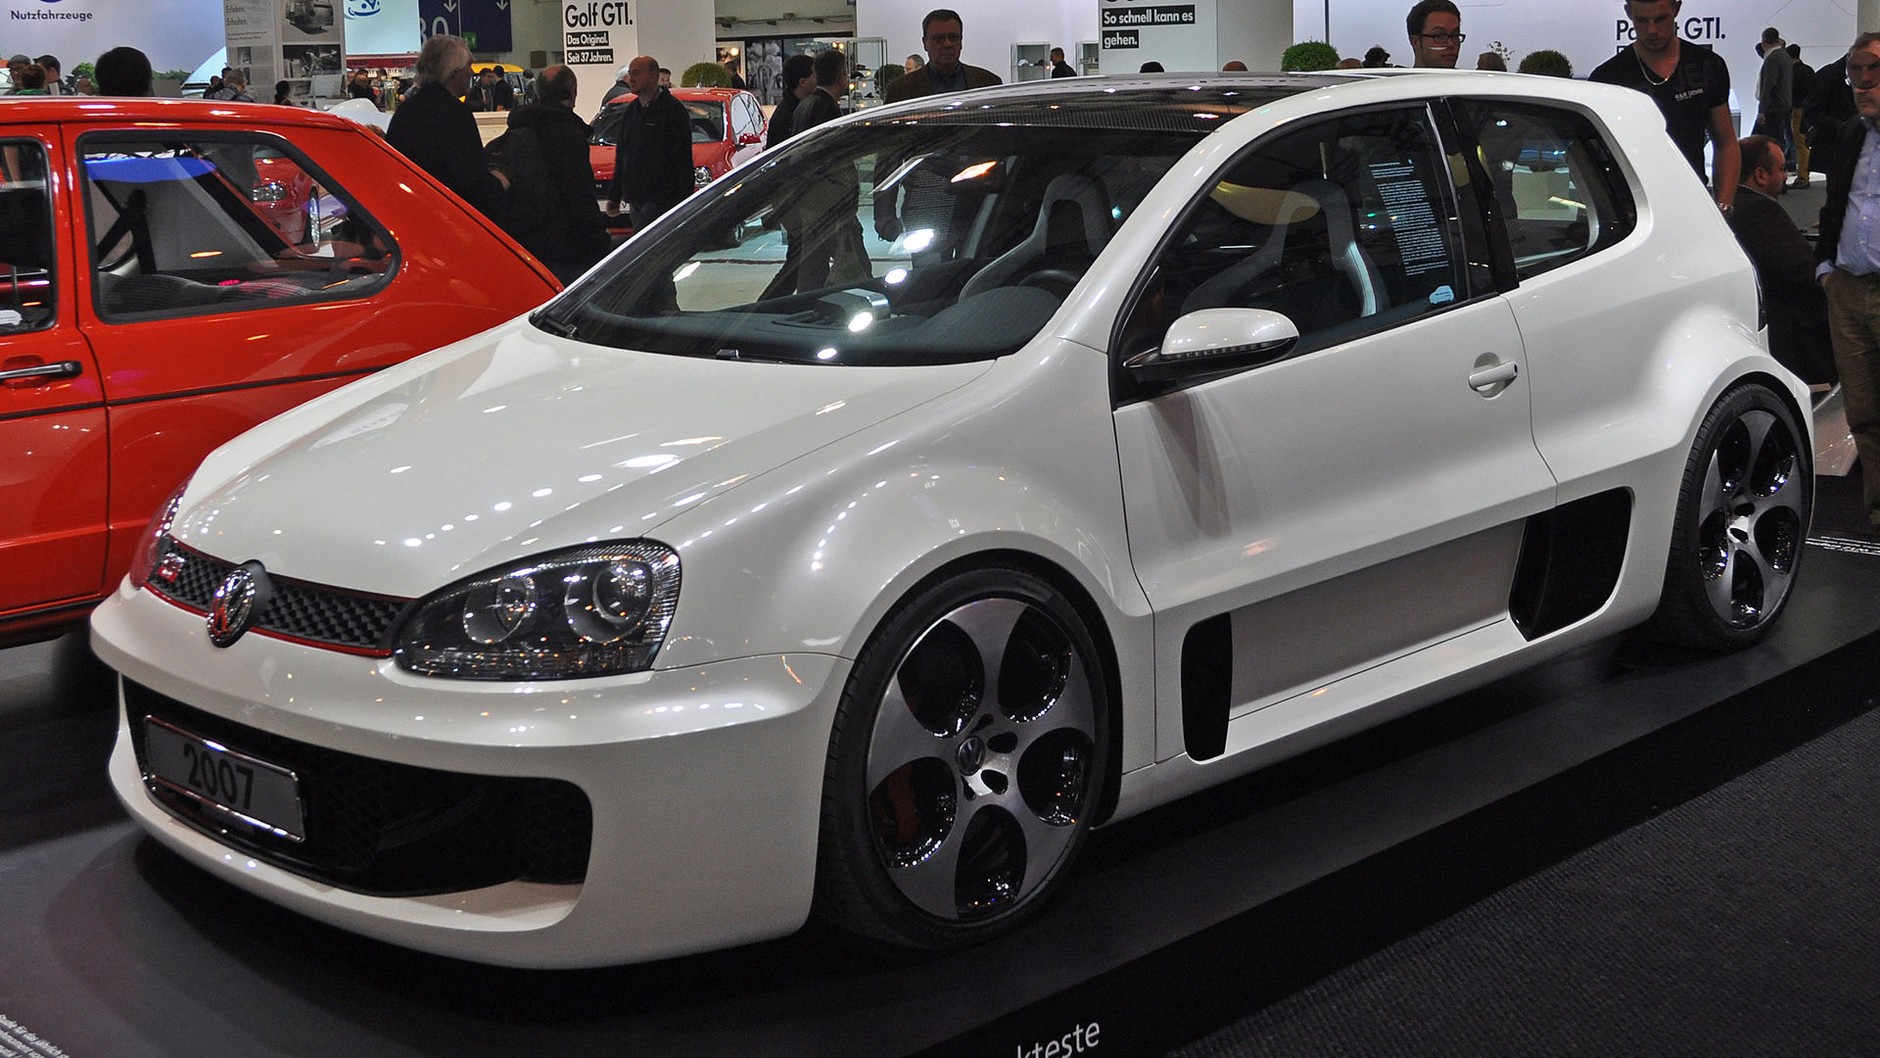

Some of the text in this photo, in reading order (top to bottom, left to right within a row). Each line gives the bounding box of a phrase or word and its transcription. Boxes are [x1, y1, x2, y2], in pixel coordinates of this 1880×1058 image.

[10, 9, 93, 22] Nutzfahrzeuge
[565, 1, 633, 28] Golf GTI.
[1103, 8, 1194, 24] So schnell kann es
[1684, 16, 1726, 40] GTI.
[567, 32, 608, 46] Das Original.
[1104, 31, 1138, 49] gehen.
[567, 51, 613, 63] Seit 37 Jahren.
[183, 742, 254, 809] 2007
